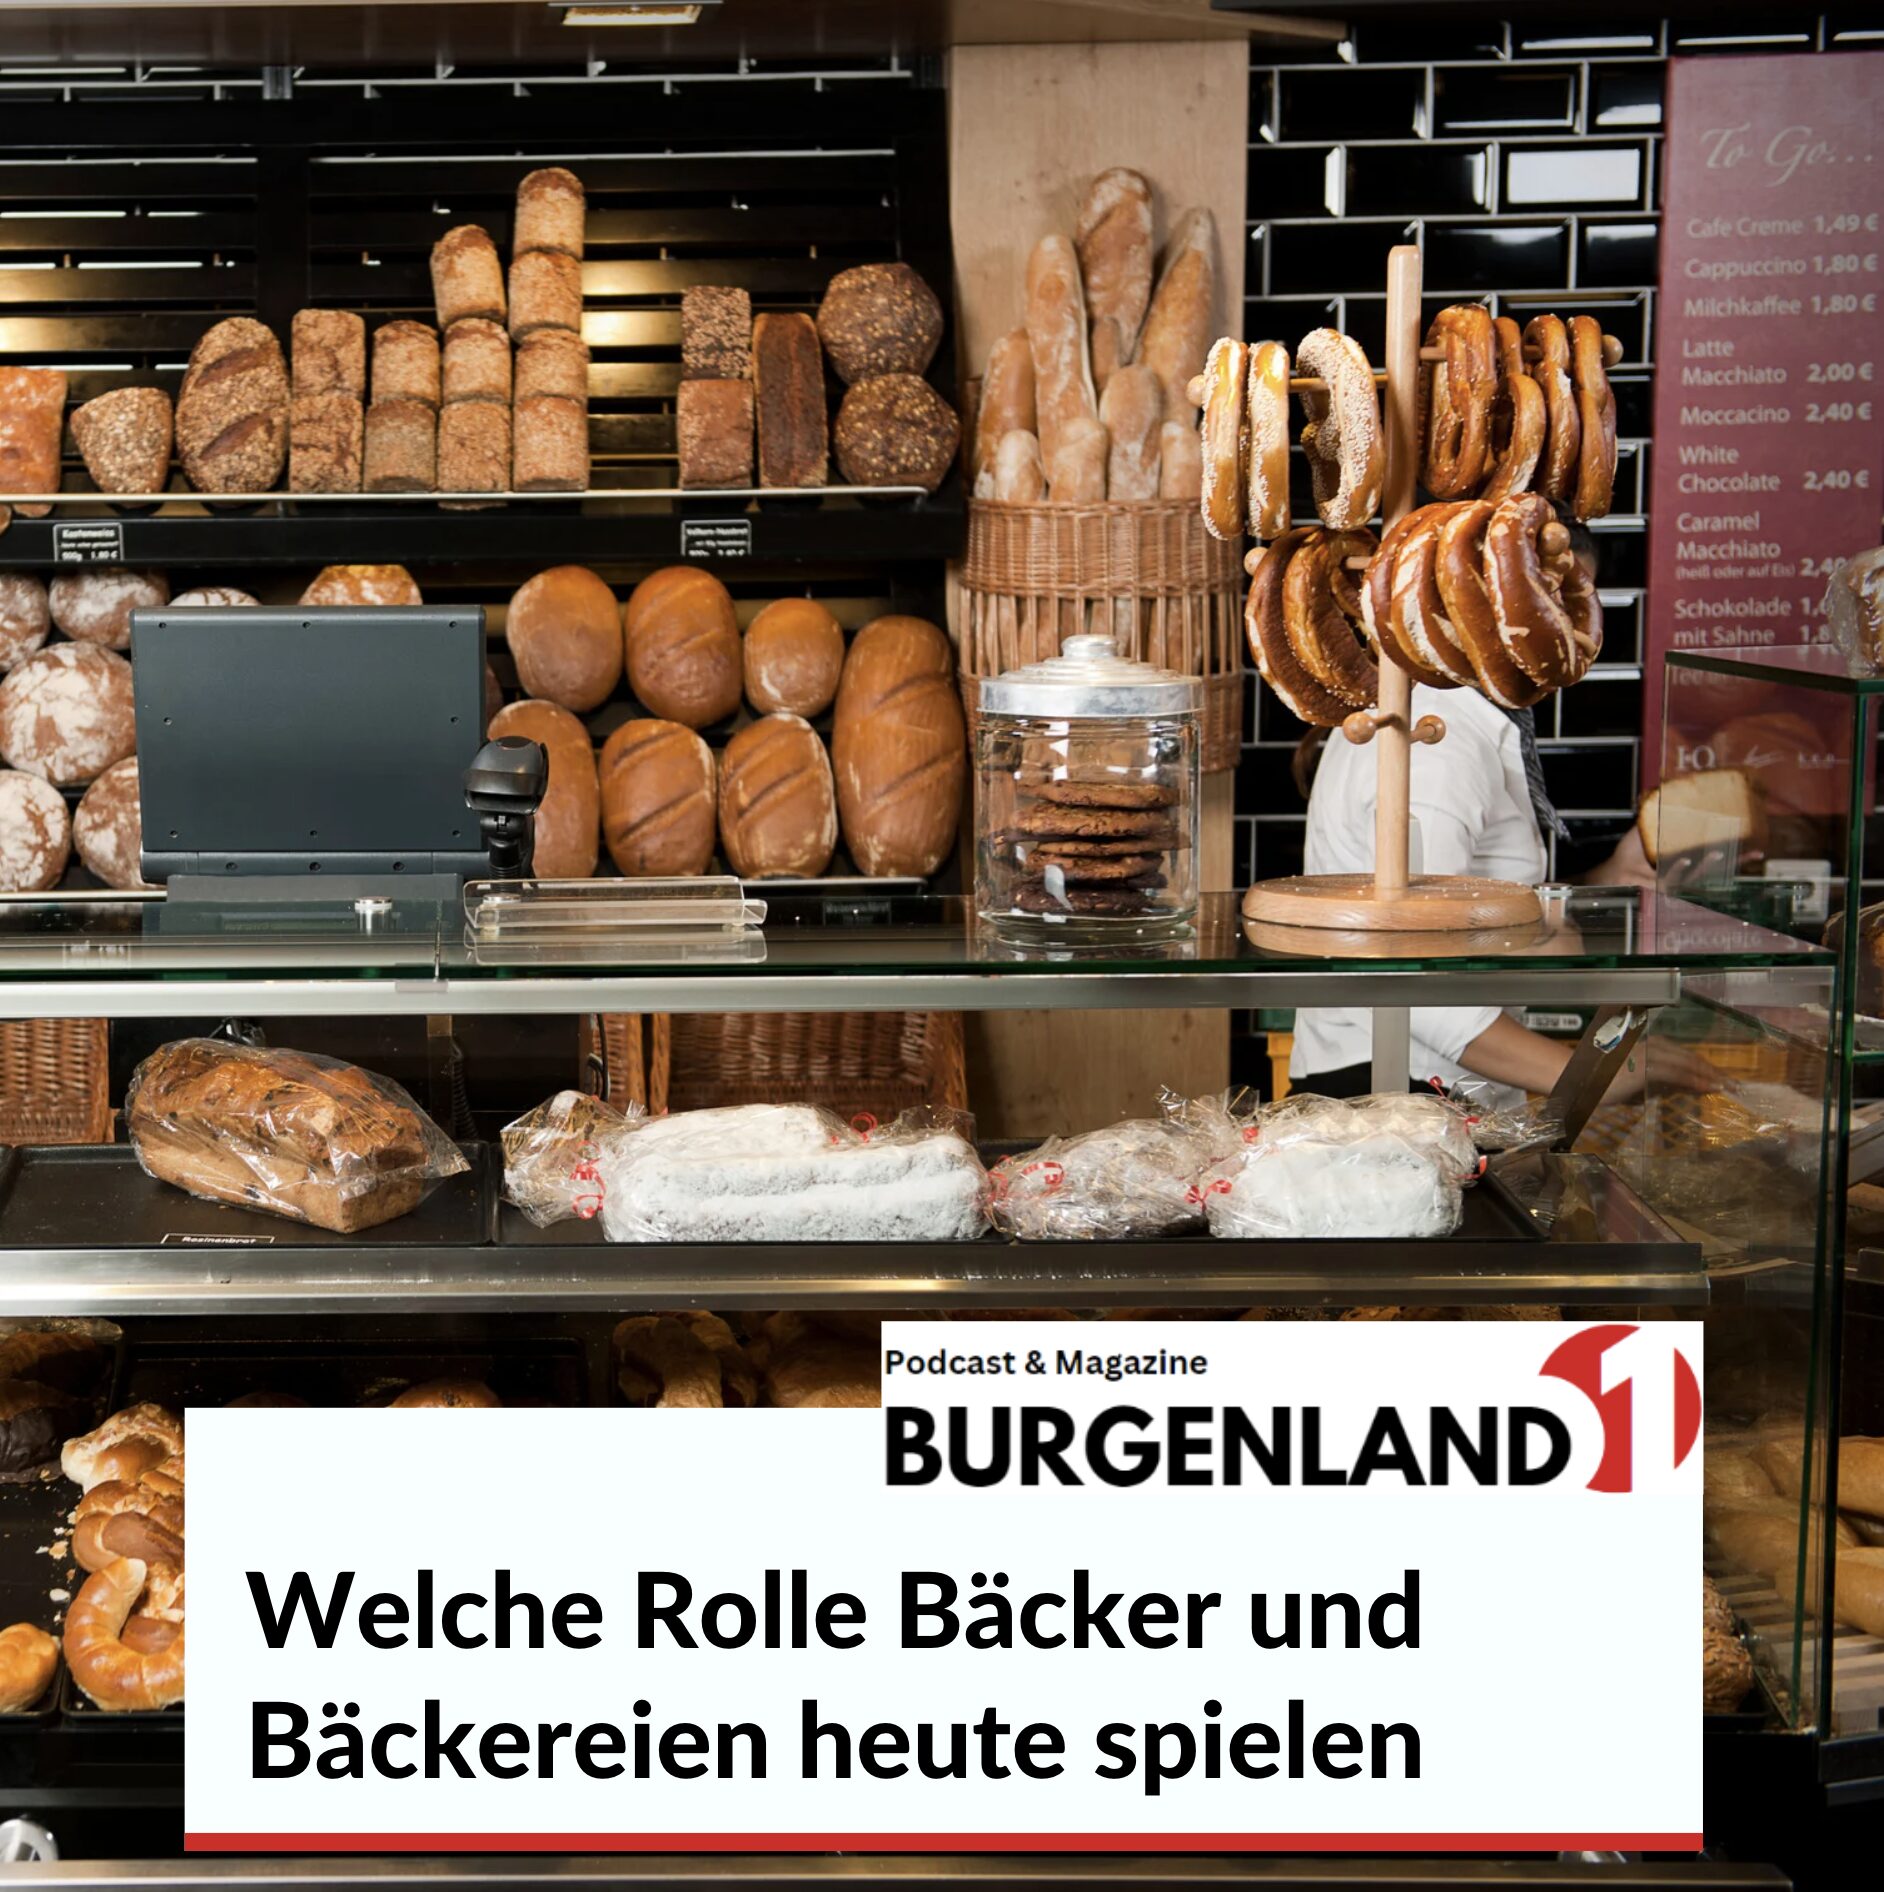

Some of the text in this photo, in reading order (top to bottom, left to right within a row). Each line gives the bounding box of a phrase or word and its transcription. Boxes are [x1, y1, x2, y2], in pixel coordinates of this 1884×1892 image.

[1700, 120, 1750, 170] To
[1687, 213, 1879, 239] Cafe Creme 1,49 €
[1684, 254, 1878, 282] Cappuccino 1,80 €
[1684, 294, 1877, 318] Milchkaffee 1,80 €
[1683, 339, 1735, 359] Latte
[1682, 362, 1874, 386] Macchiato 2,00 €
[1680, 402, 1872, 426] Moccacino 2,40 €
[1679, 446, 1740, 466] White
[1678, 470, 1869, 494] Chocolate 2,40 €
[1676, 511, 1761, 532] Caramel
[1676, 540, 1781, 561] Macchiato
[1713, 563, 1744, 579] oder
[1748, 562, 1771, 578] auf
[1674, 597, 1793, 619] Schokolade
[1673, 627, 1707, 647] mit
[1712, 624, 1776, 646] Sahne
